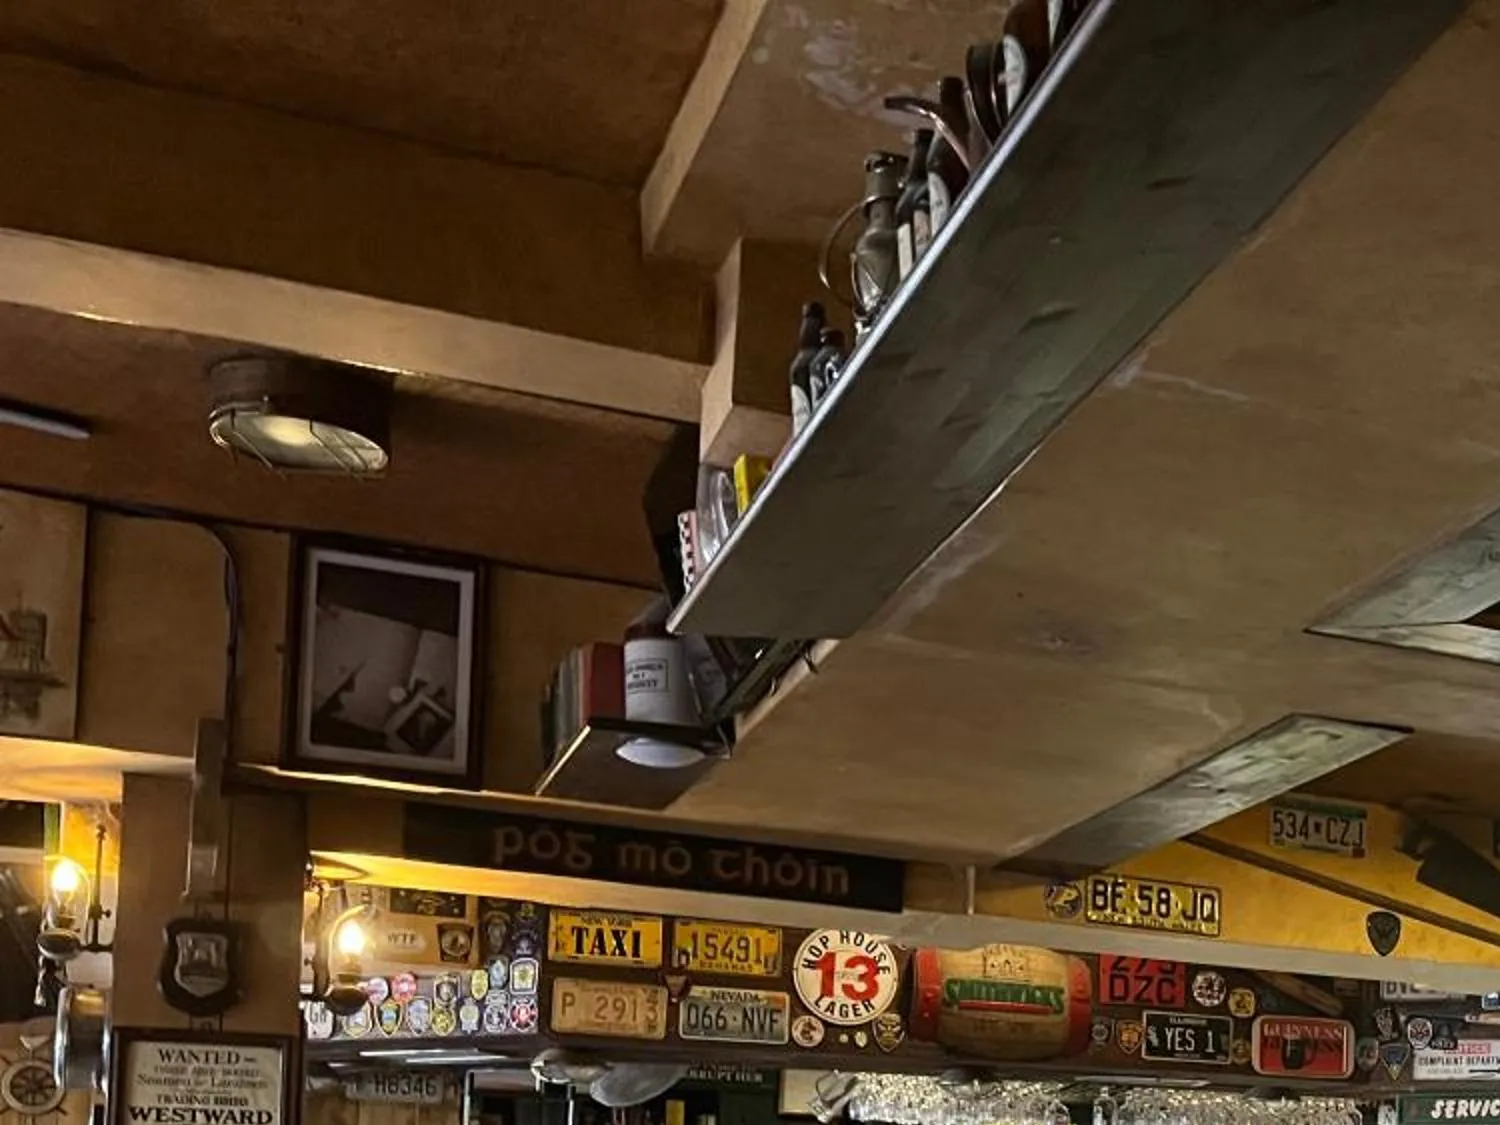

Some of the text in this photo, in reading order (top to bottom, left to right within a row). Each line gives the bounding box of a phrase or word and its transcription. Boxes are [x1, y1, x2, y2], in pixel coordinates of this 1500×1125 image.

[572, 927, 642, 959] TAXI
[802, 930, 892, 976] HOP HOUSE
[815, 951, 880, 1001] 13
[562, 992, 576, 1017] P
[814, 994, 876, 1018] LAGER
[1164, 1027, 1196, 1051] YES
[158, 1048, 241, 1065] WANTED
[128, 1103, 274, 1125] WESTWARD
